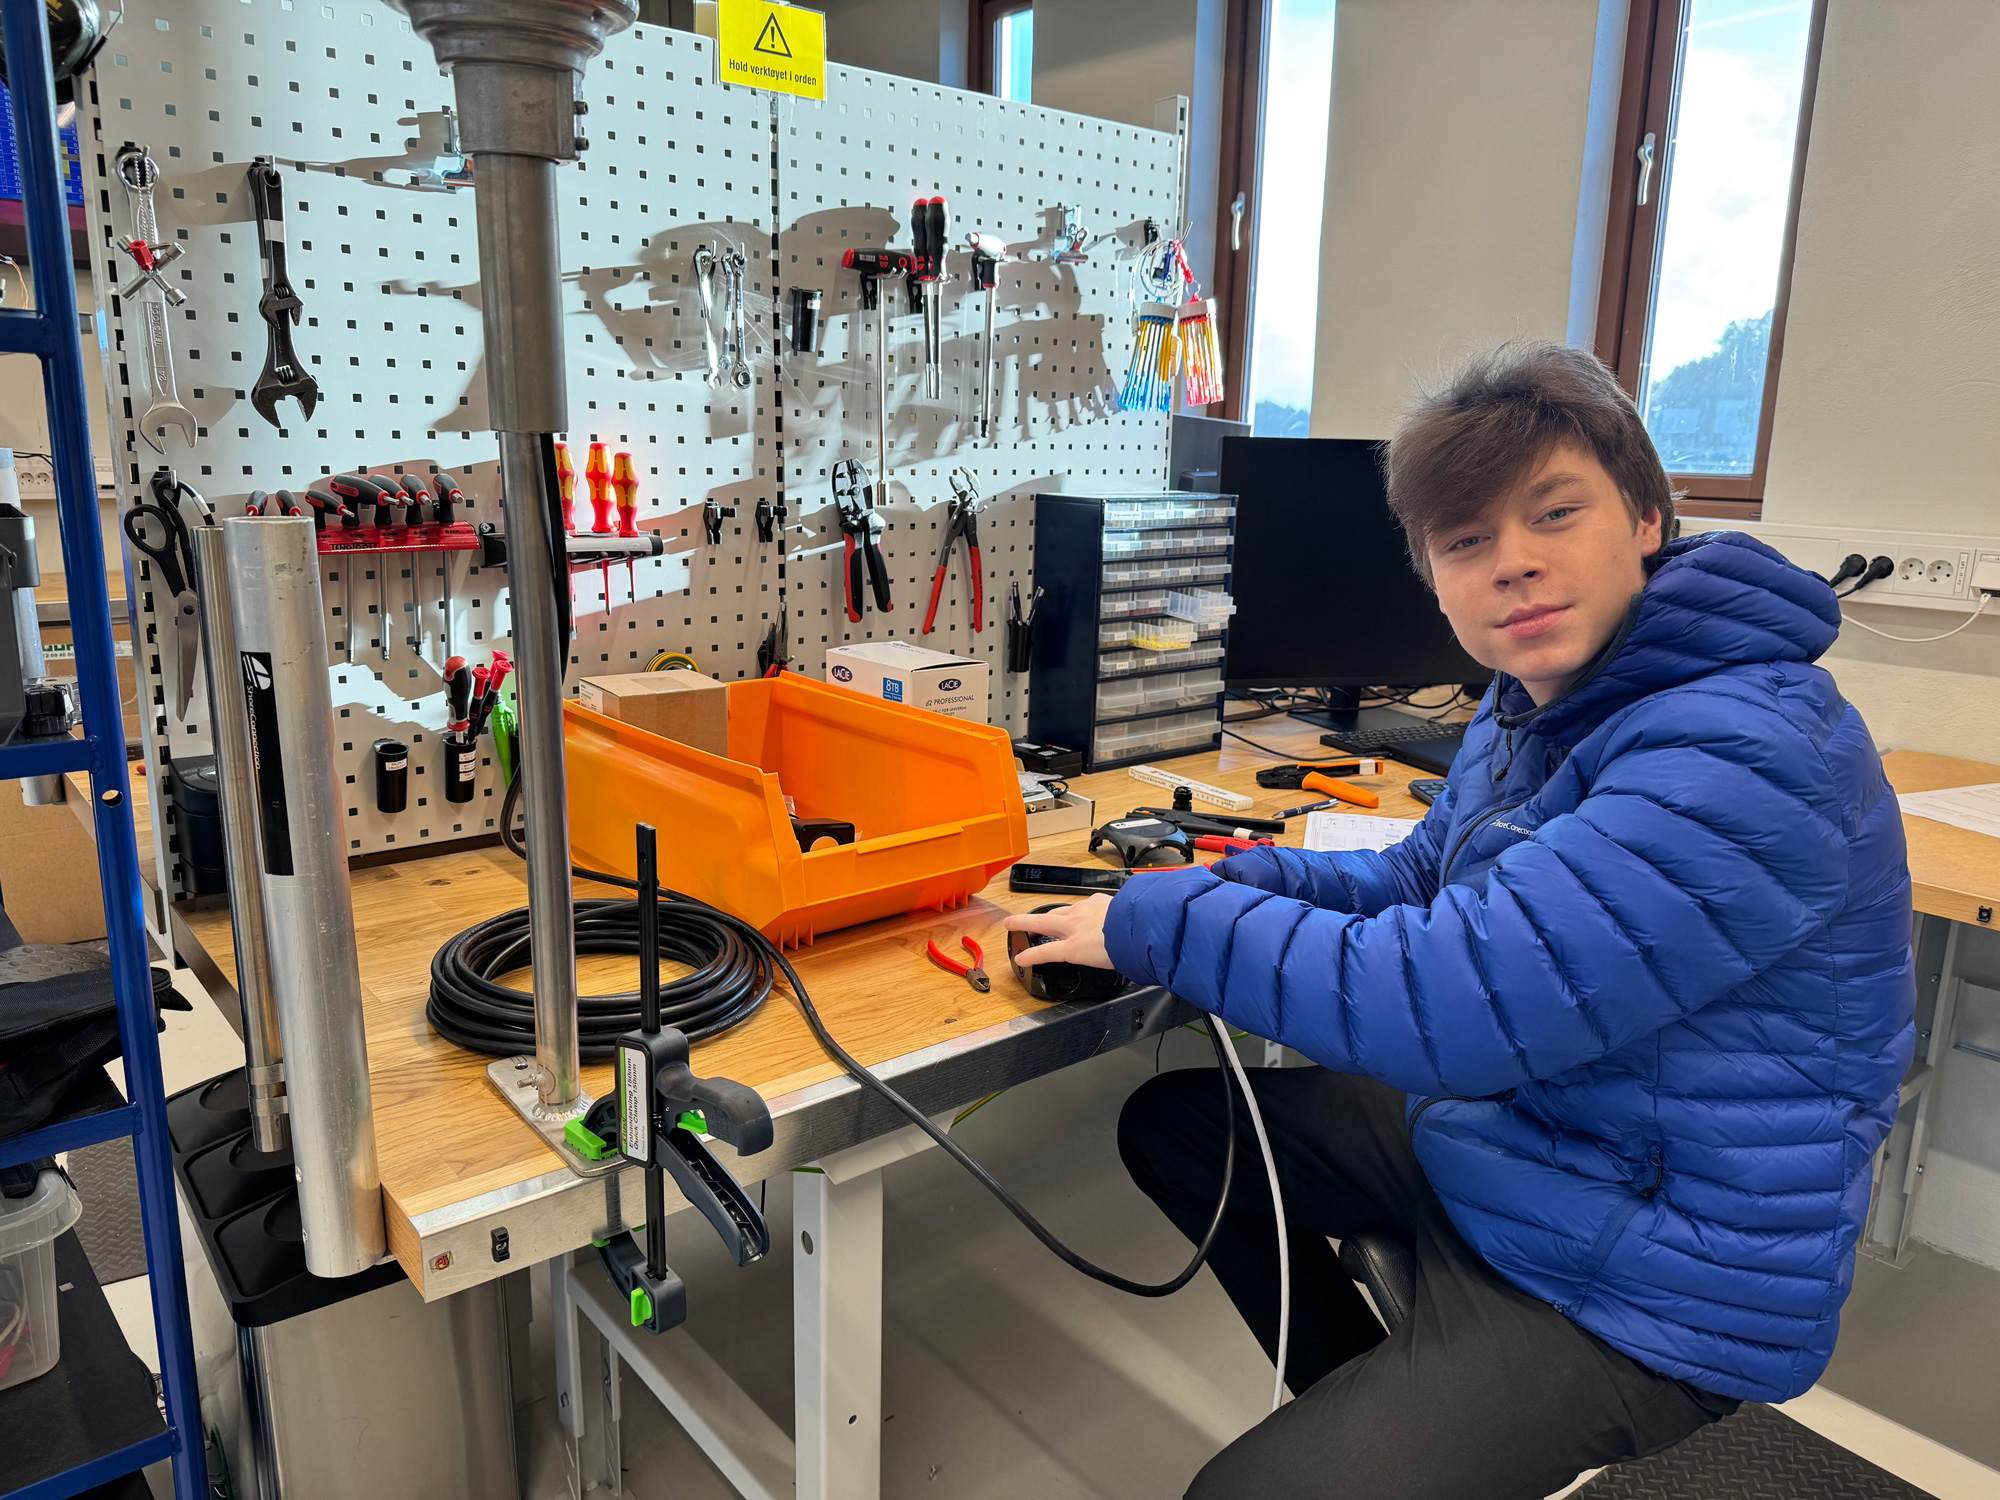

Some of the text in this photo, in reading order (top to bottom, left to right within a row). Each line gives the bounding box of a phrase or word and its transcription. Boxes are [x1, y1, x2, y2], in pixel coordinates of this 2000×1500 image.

[729, 58, 817, 86] Hold verktøyet i orden
[885, 679, 900, 694] 8TB
[925, 694, 975, 707] d2 PROFESSIONAL
[246, 685, 261, 770] ShoreConnection
